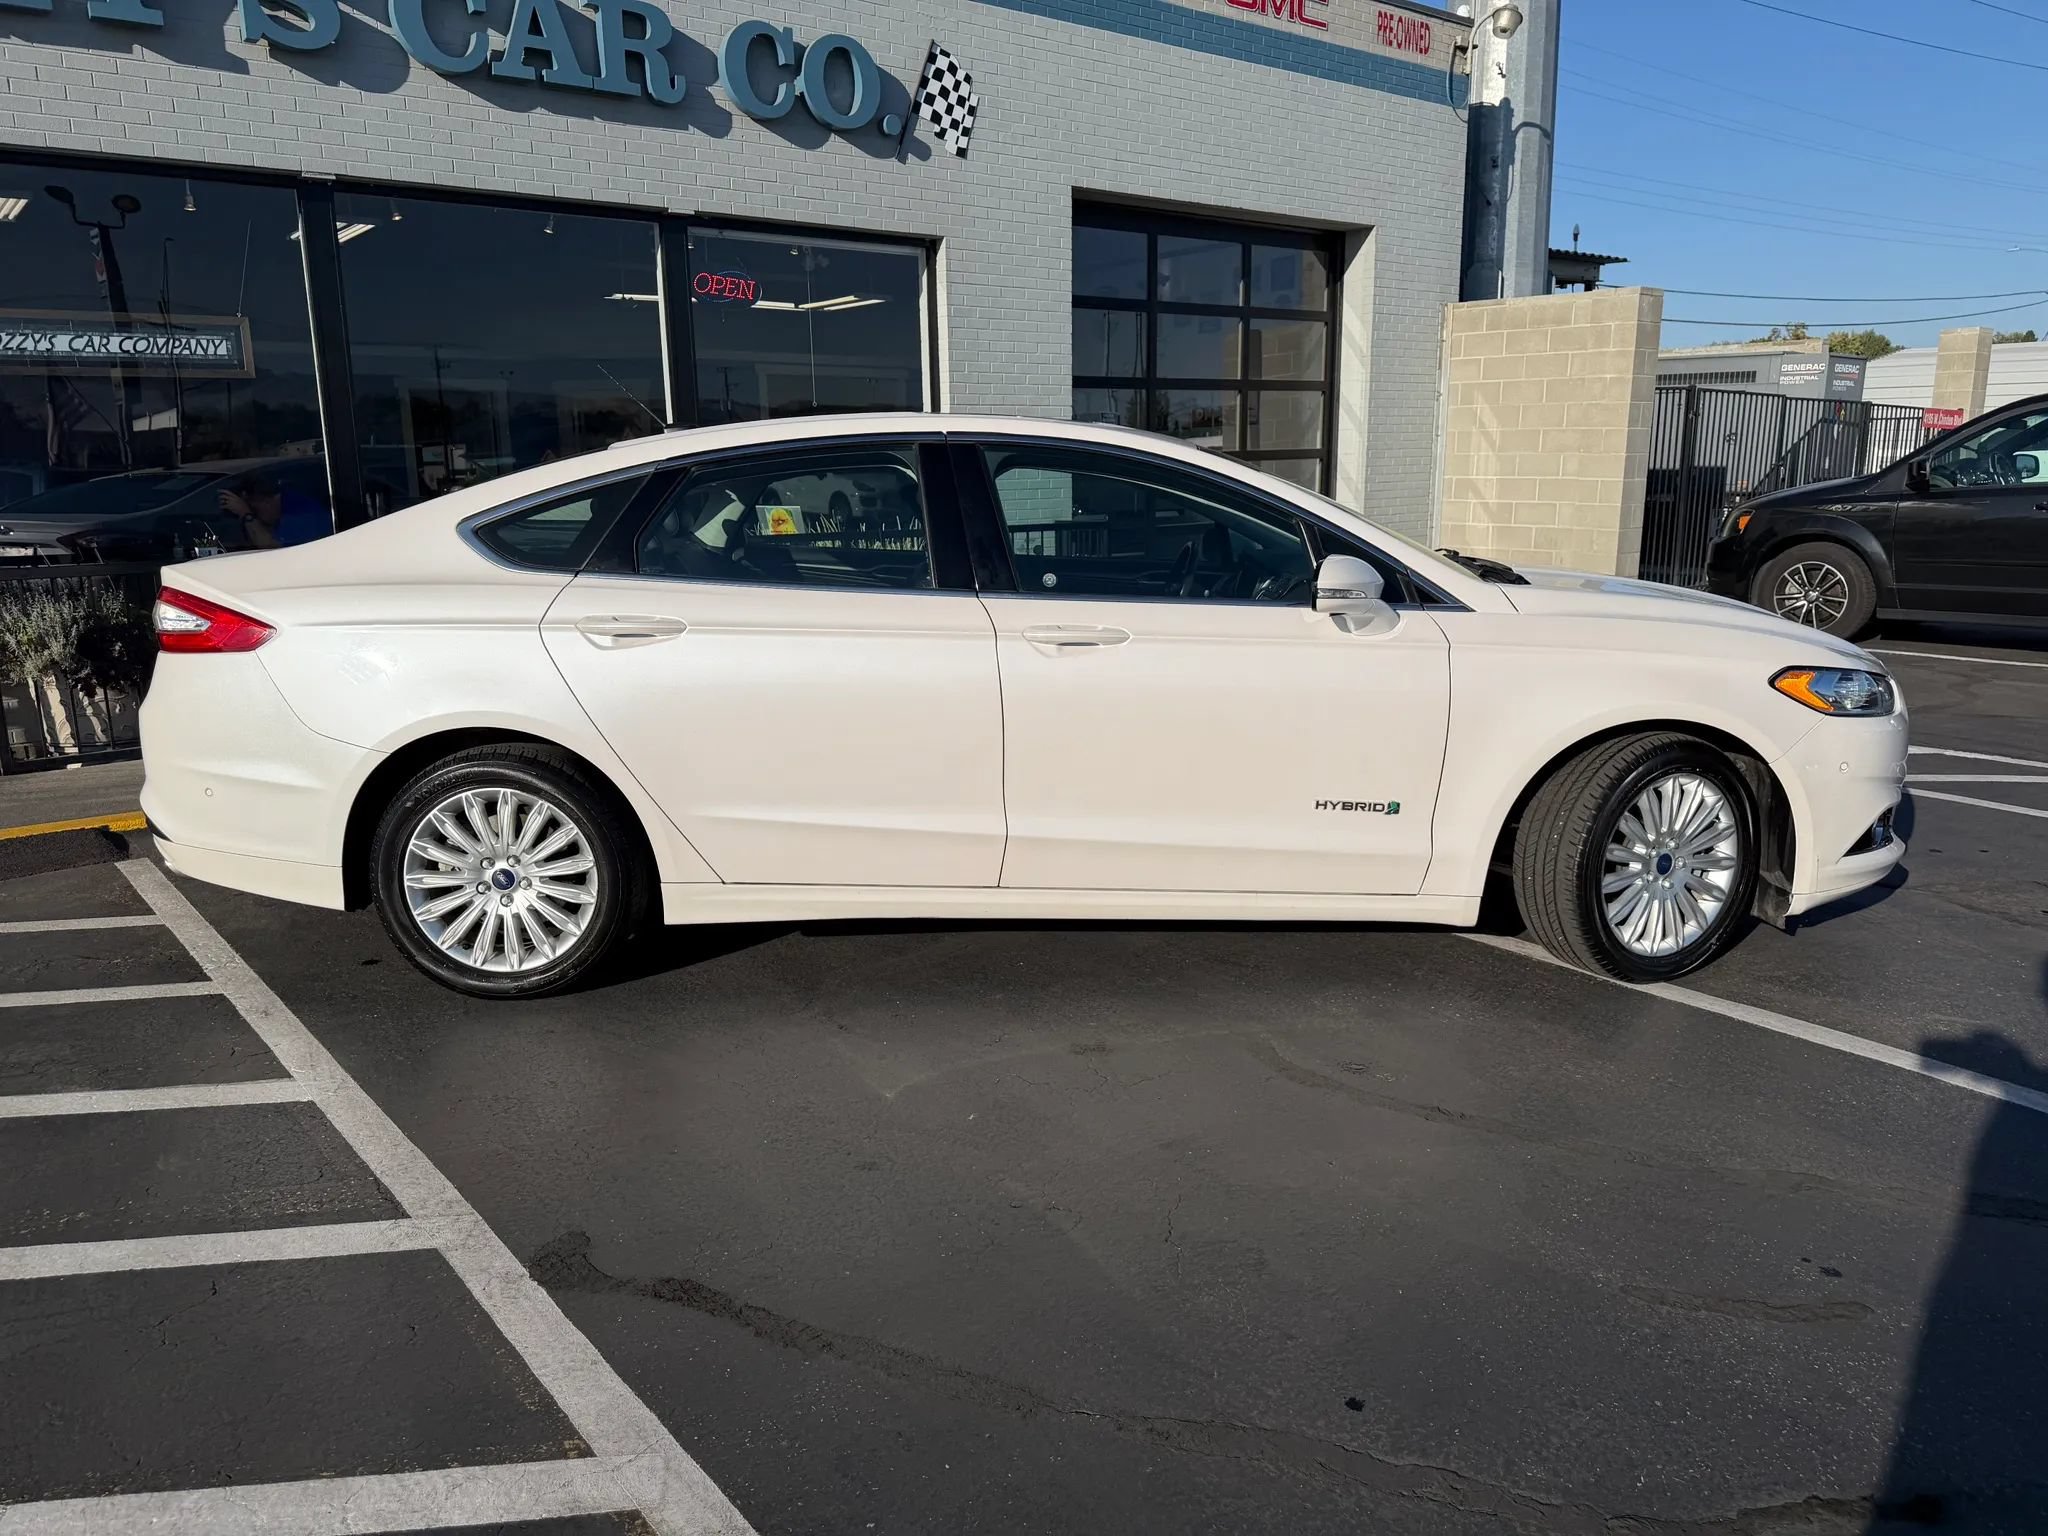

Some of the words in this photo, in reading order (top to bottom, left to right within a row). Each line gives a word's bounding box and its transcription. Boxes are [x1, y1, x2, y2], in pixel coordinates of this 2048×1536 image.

[1377, 10, 1431, 56] PRE-OWNED
[388, 0, 687, 104] CAR
[718, 20, 901, 136] CO.
[694, 272, 756, 300] OPEN
[68, 335, 111, 354] CAR
[118, 336, 227, 356] COMPANY
[1781, 363, 1825, 371] GENERAC
[1835, 364, 1859, 373] GENERAC
[1315, 800, 1386, 812] HYBRID
